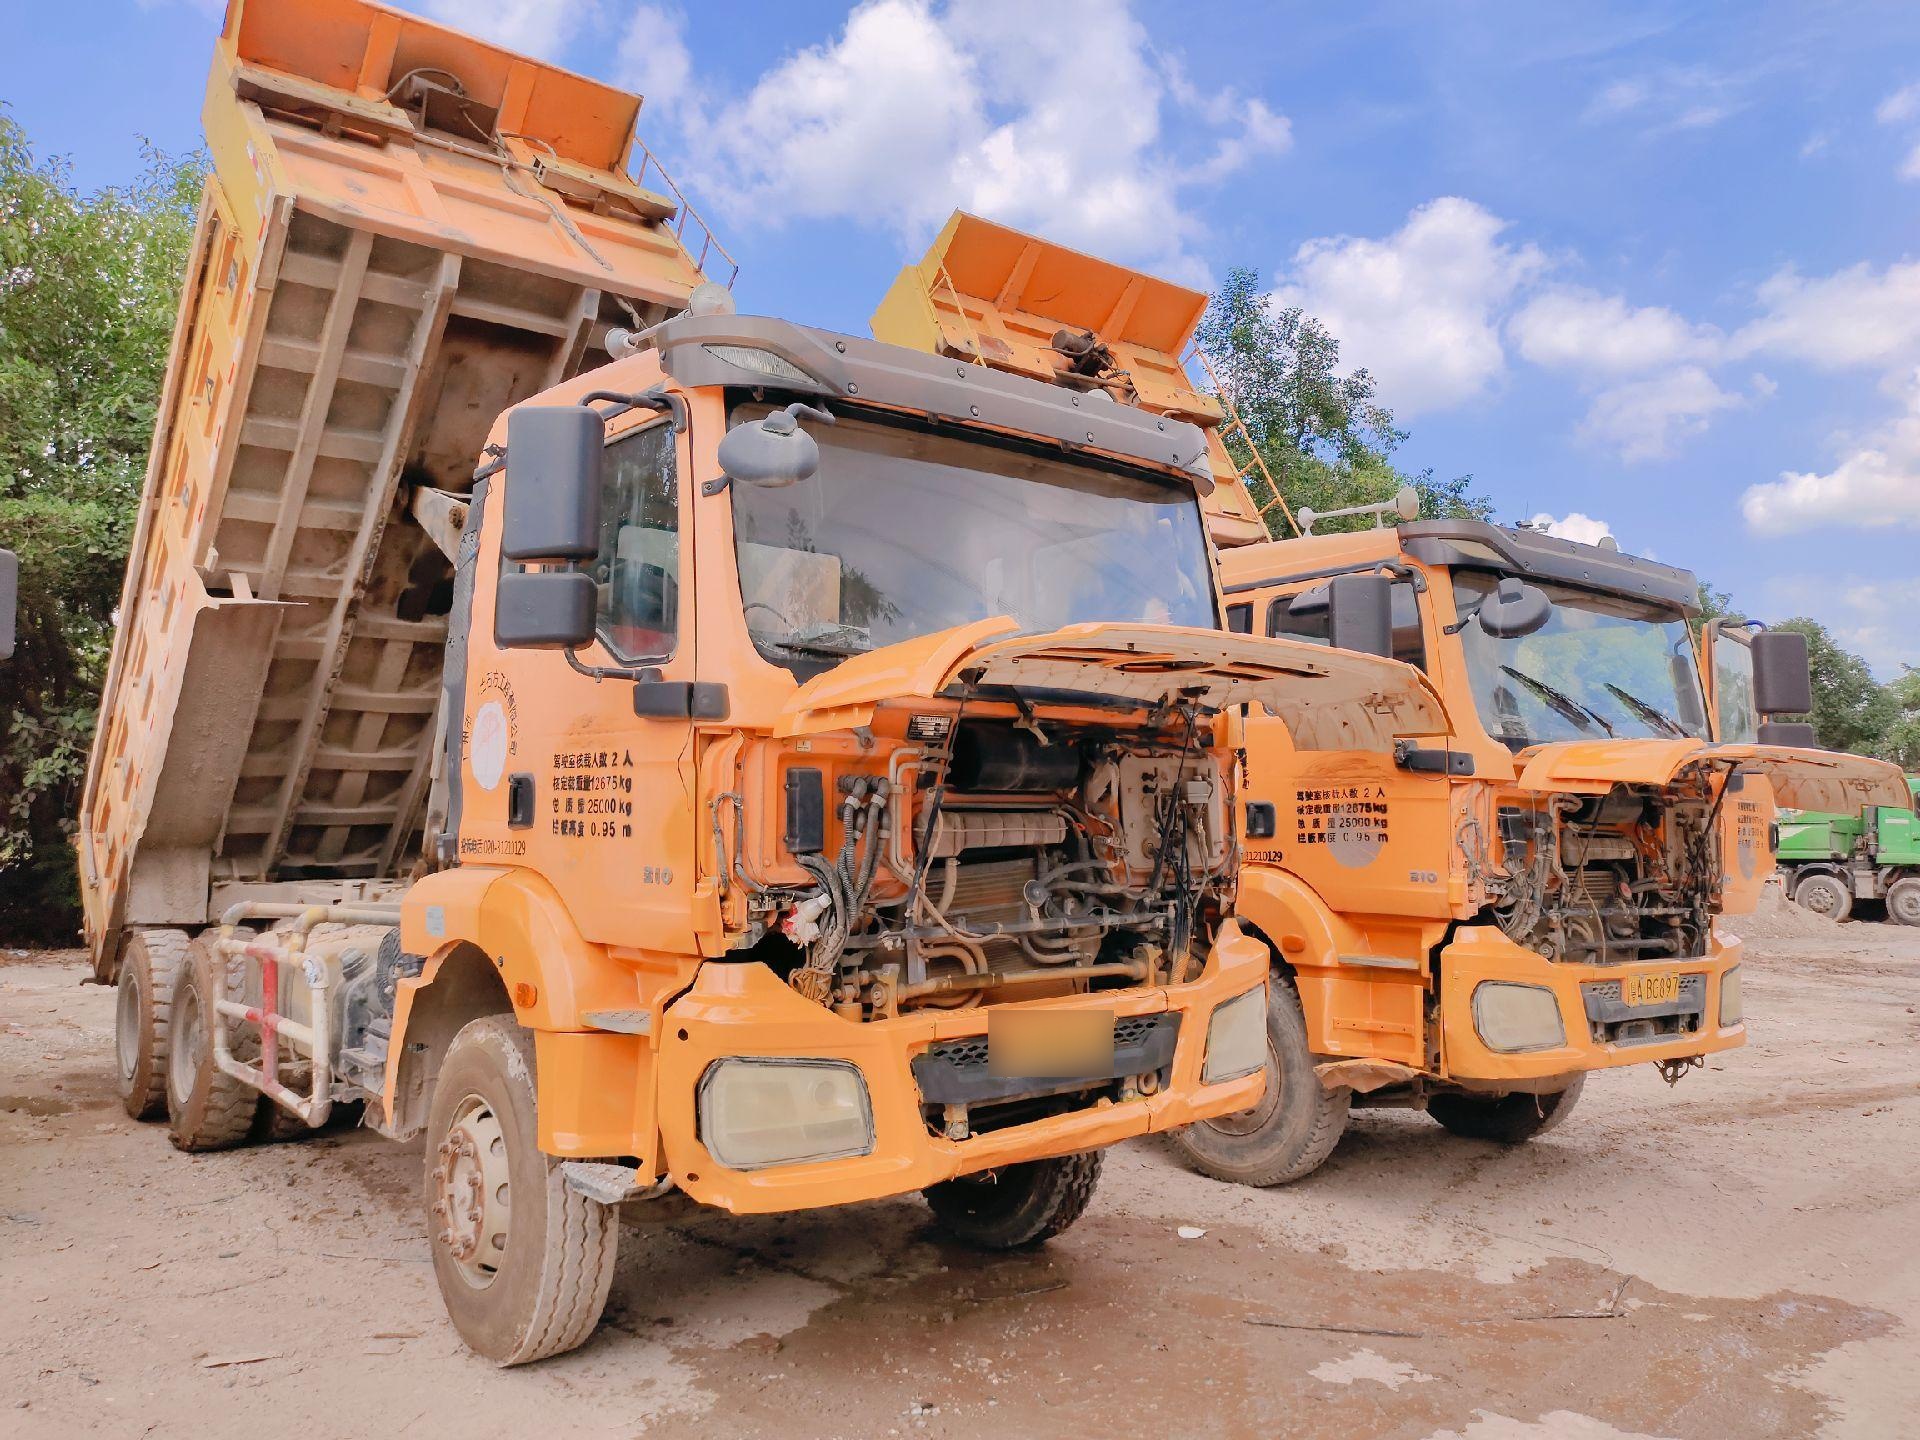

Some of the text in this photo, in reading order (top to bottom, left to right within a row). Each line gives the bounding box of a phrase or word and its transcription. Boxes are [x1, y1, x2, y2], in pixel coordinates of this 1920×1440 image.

[553, 749, 634, 769] 驾驶室核载人数 2 人
[1363, 787, 1370, 798] 2
[1376, 786, 1386, 798] 人
[590, 821, 616, 837] 0.95
[1378, 832, 1389, 843] m
